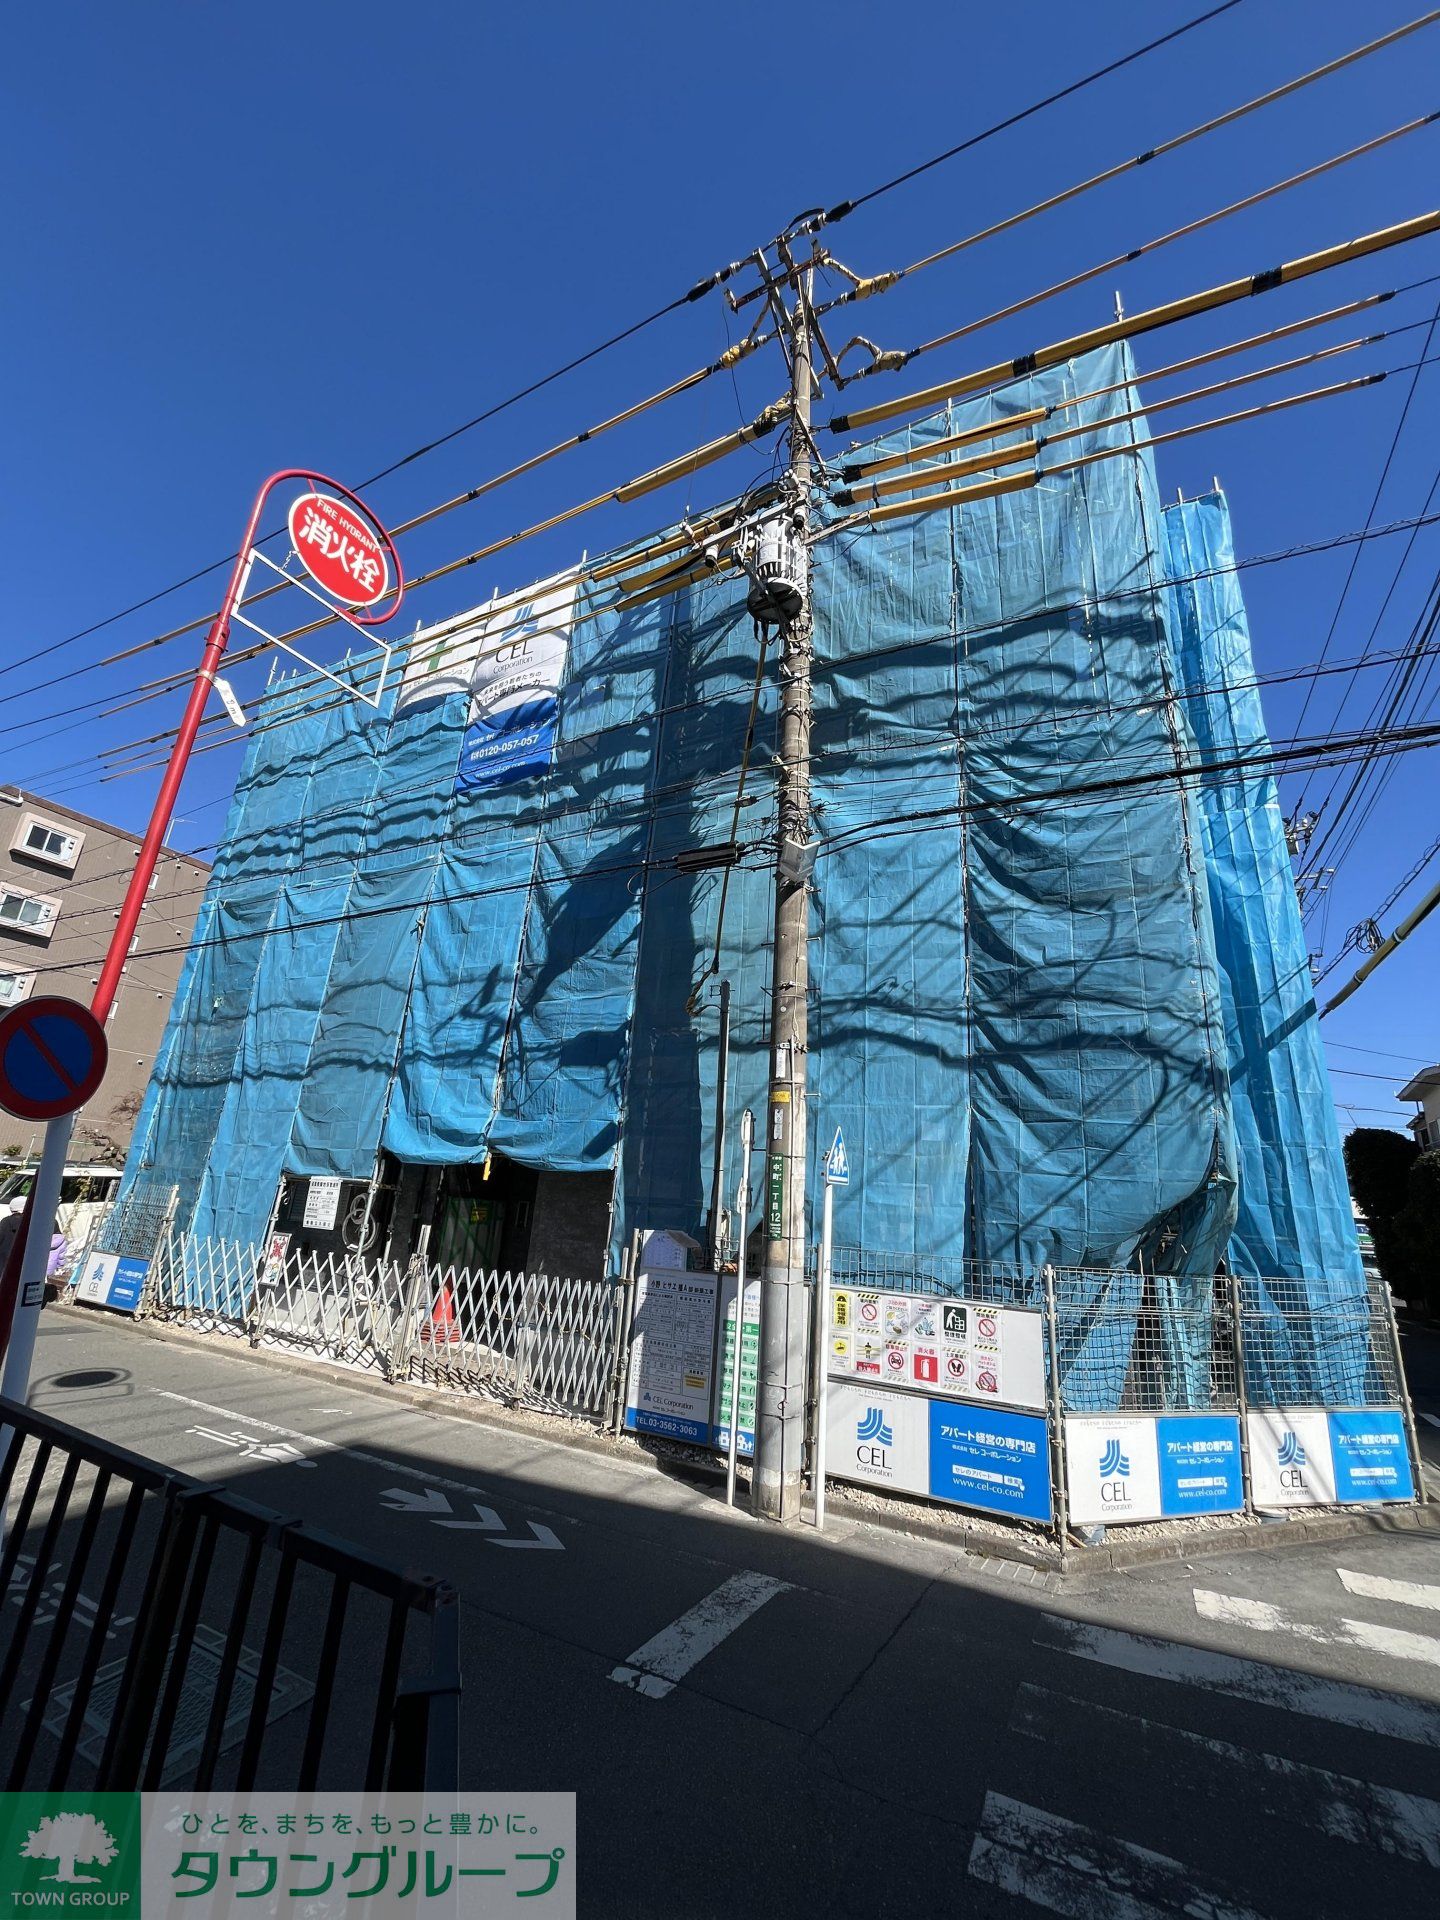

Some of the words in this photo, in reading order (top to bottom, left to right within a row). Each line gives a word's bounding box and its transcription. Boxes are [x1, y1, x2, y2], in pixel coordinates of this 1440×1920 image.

[317, 499, 338, 520] FIRE
[340, 517, 378, 553] HYDRANT
[299, 507, 380, 592] 消火栓
[496, 640, 534, 663] CEL
[493, 656, 533, 675] Corporation
[479, 735, 539, 758] 0120-057-057
[771, 1213, 781, 1222] 12
[663, 1399, 694, 1411] Corporation
[649, 1418, 698, 1436] 03-3562-3063
[941, 1425, 1035, 1454] アパート経営の専門店
[1167, 1440, 1233, 1453] アパート経営の専門店
[857, 1445, 892, 1470] CEL
[856, 1463, 893, 1478] Corporation
[1280, 1470, 1308, 1488] CEL
[953, 1477, 1024, 1499] www.cel-co.com
[1101, 1481, 1131, 1502] CEL
[1178, 1488, 1227, 1498] www.cel-co.com
[1101, 1503, 1133, 1512] Corporation
